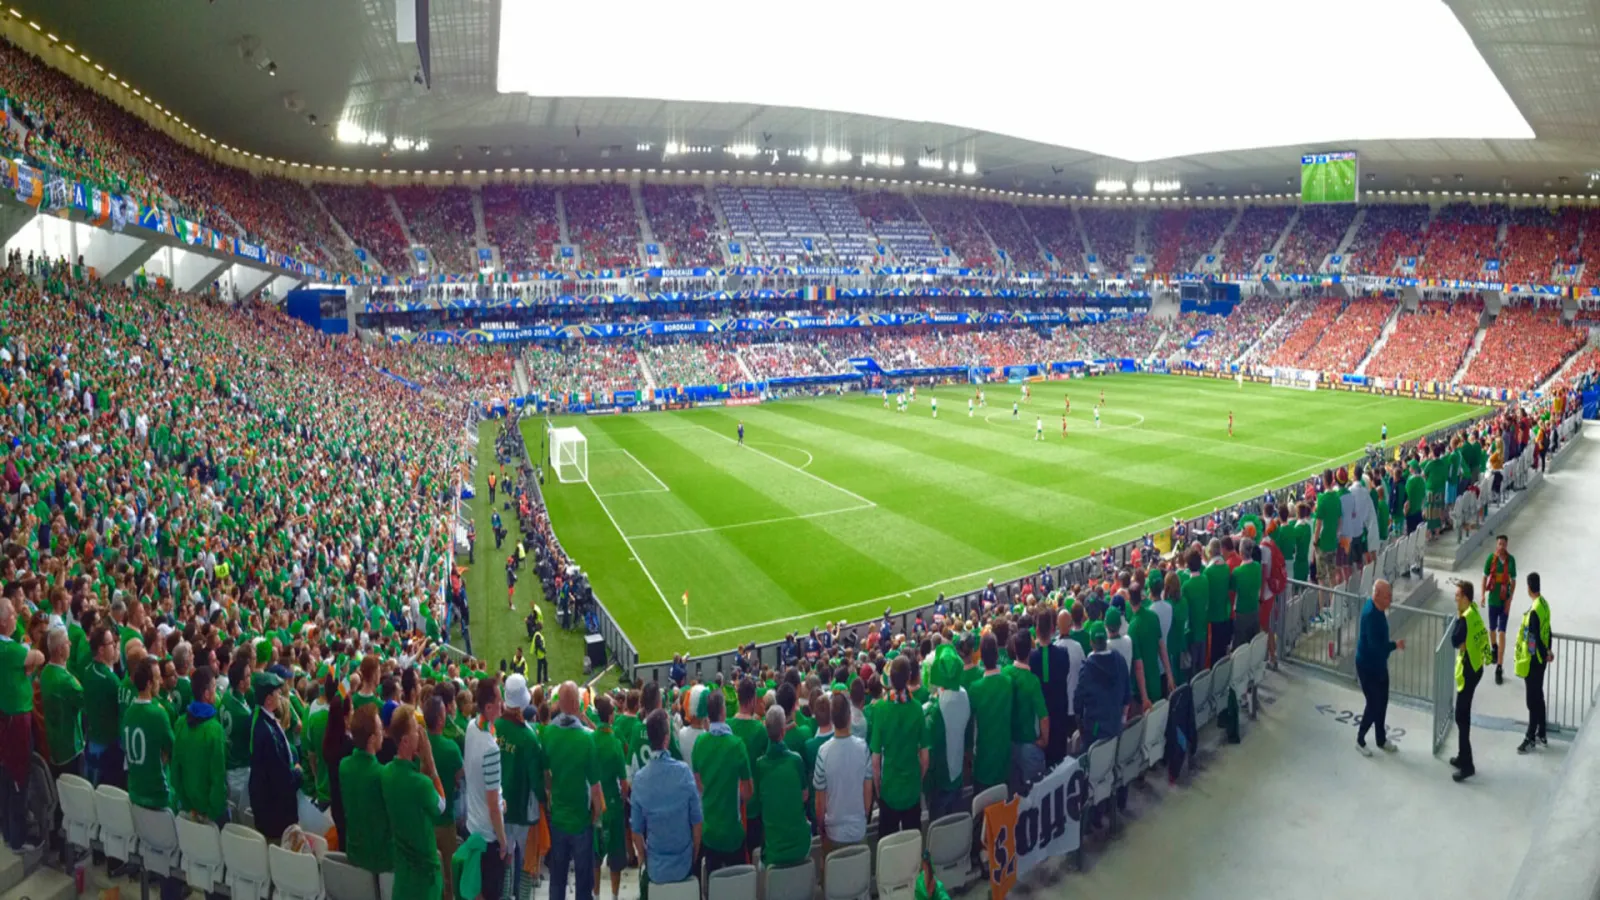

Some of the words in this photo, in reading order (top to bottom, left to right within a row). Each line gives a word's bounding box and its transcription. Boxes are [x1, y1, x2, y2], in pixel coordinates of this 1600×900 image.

[662, 268, 693, 277] BORDEAUX
[664, 323, 695, 332] BORDEAUX
[497, 331, 514, 340] UEFA
[515, 328, 532, 340] EURO
[534, 327, 550, 336] 2016
[124, 726, 146, 764] 10
